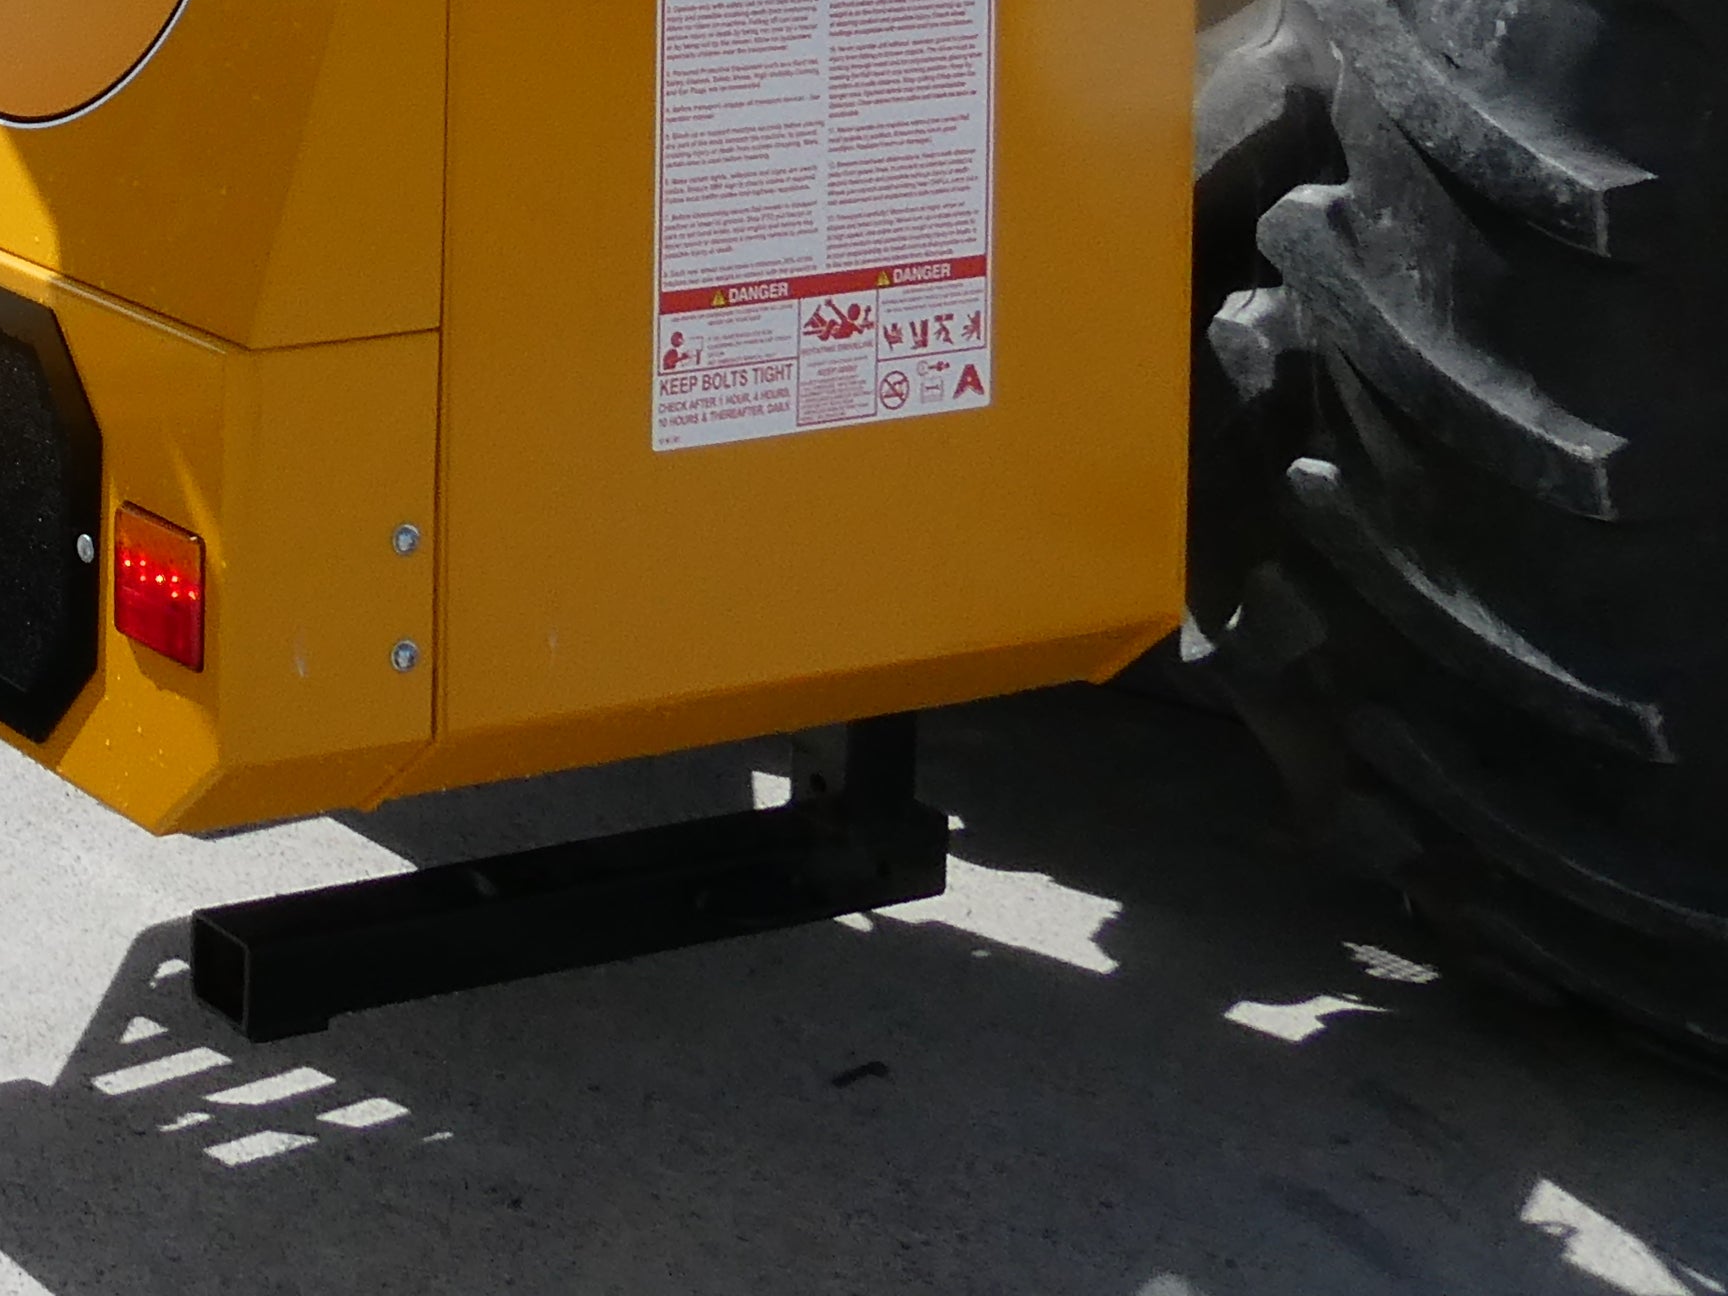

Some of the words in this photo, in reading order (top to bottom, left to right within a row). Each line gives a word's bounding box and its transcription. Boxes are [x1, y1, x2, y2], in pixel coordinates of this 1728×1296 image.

[894, 262, 951, 284] DANGER
[727, 282, 789, 304] DANGER
[659, 375, 698, 396] KEEP
[701, 368, 748, 391] BOLTS
[752, 363, 793, 385] TIGHT
